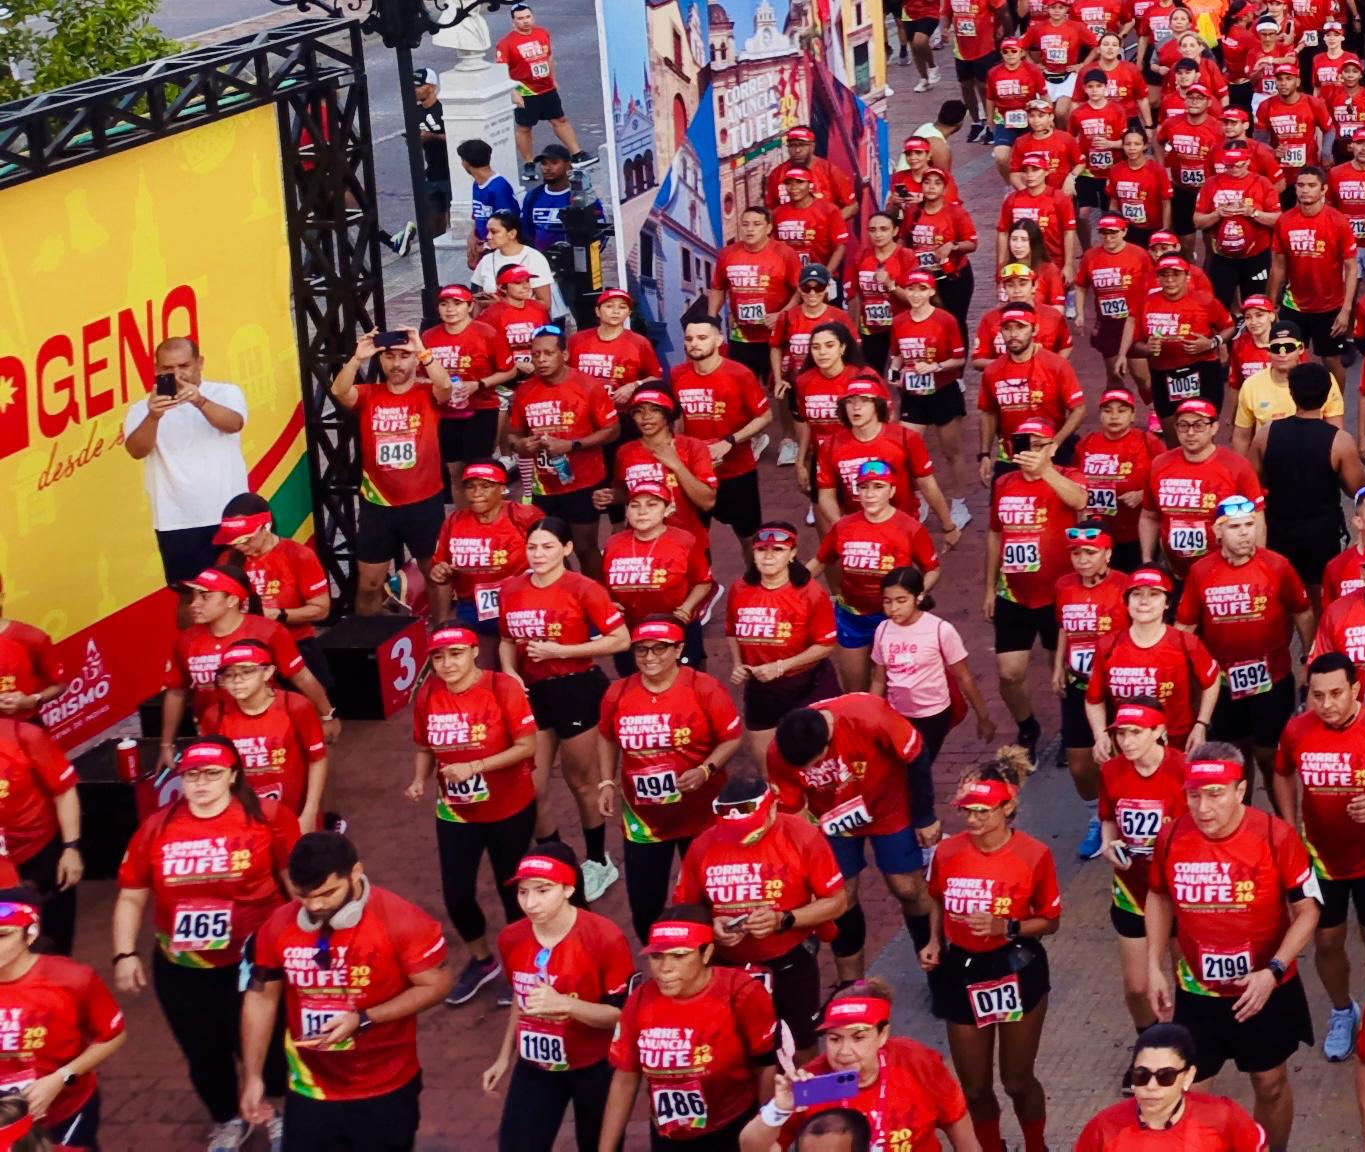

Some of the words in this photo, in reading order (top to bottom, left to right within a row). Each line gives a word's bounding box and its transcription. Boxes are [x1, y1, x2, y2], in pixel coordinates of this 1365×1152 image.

[724, 76, 765, 106] CORRE
[728, 88, 777, 125] ANUNCIA
[729, 119, 754, 154] TU
[756, 108, 779, 142] FE
[1183, 171, 1204, 183] 845
[1102, 299, 1127, 315] 1292
[1171, 374, 1200, 394] 1005
[37, 420, 104, 491] desde
[381, 444, 413, 462] 848
[1173, 531, 1205, 550] 1249
[1005, 545, 1038, 564] 903
[889, 641, 918, 654] take
[390, 637, 416, 692] 3
[1232, 667, 1269, 690] 1592
[637, 773, 676, 797] 494
[1123, 811, 1159, 836] 522
[176, 914, 228, 939] 465
[1206, 957, 1249, 979] 2199
[978, 984, 1018, 1013] 073
[523, 1035, 563, 1062] 1198
[658, 1092, 705, 1119] 486
